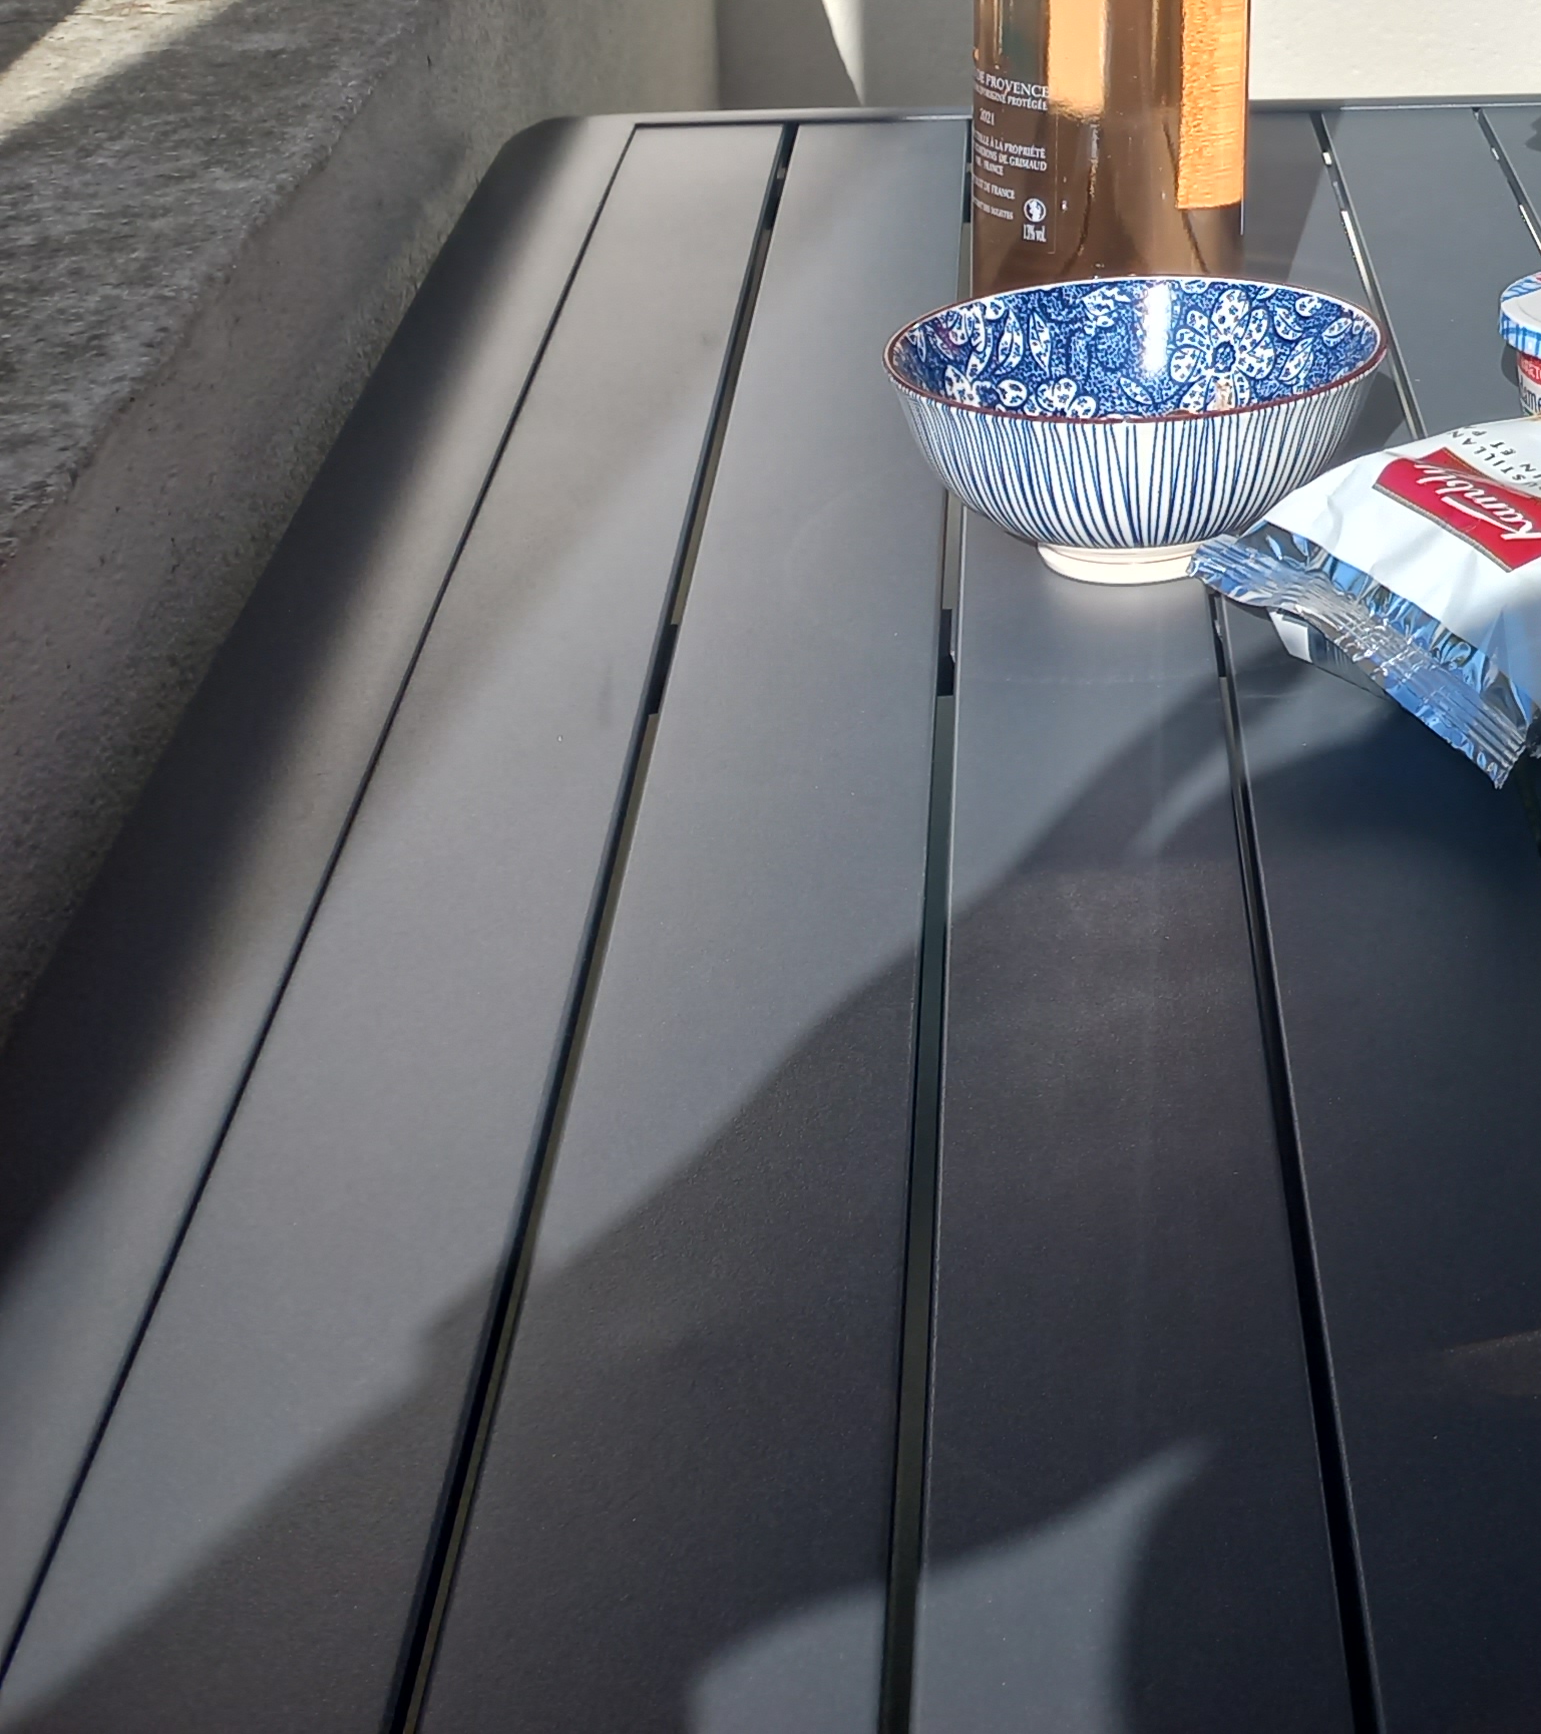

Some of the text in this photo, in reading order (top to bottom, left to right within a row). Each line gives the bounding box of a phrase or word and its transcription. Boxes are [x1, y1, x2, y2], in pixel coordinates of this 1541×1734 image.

[986, 74, 1050, 99] PROVENCE
[980, 108, 996, 126] 2021
[1004, 141, 1047, 160] PROPRIÉTÉ
[1009, 156, 1048, 172] GRIMAUD
[1490, 440, 1518, 456] ET
